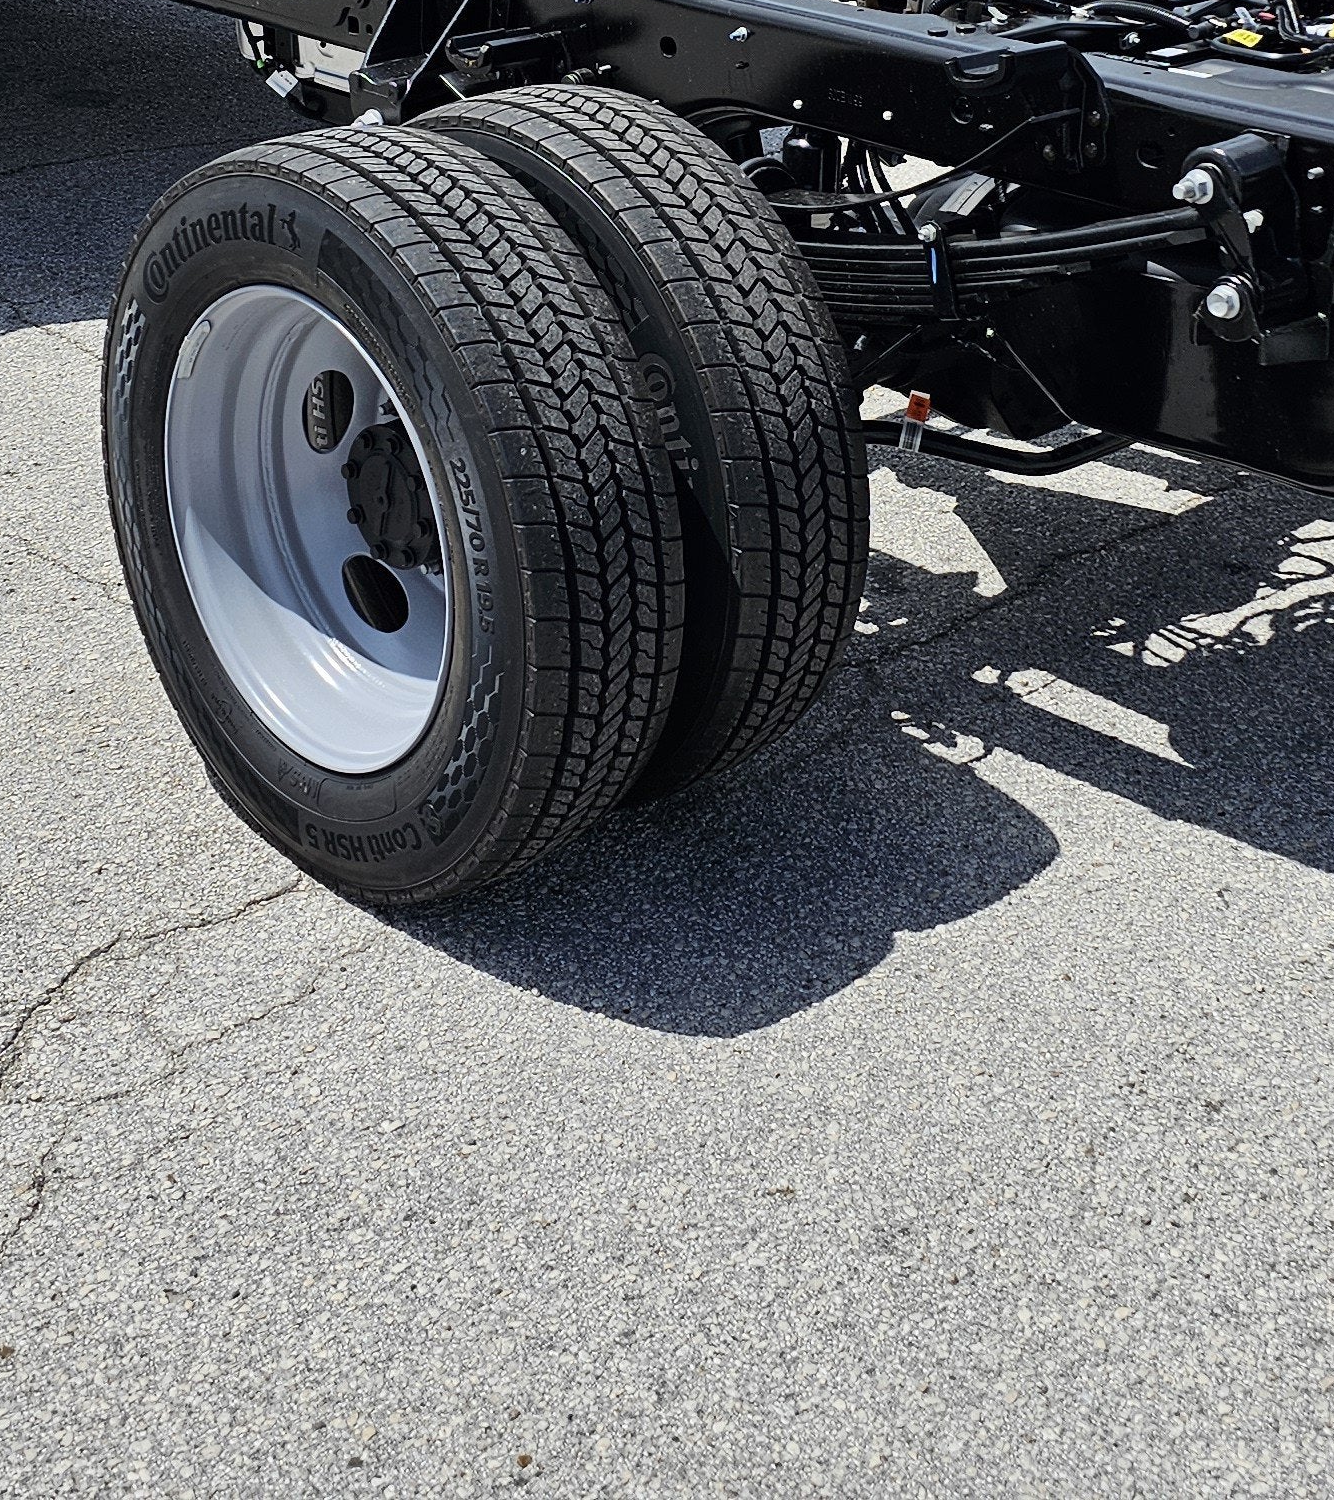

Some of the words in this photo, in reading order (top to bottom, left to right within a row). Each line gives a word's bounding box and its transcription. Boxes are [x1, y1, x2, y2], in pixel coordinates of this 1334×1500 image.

[142, 202, 277, 305] Continental
[449, 457, 486, 552] 225/70
[472, 557, 490, 577] R
[475, 582, 495, 635] 19.5
[321, 828, 368, 863] HSR
[366, 822, 422, 863] Conti
